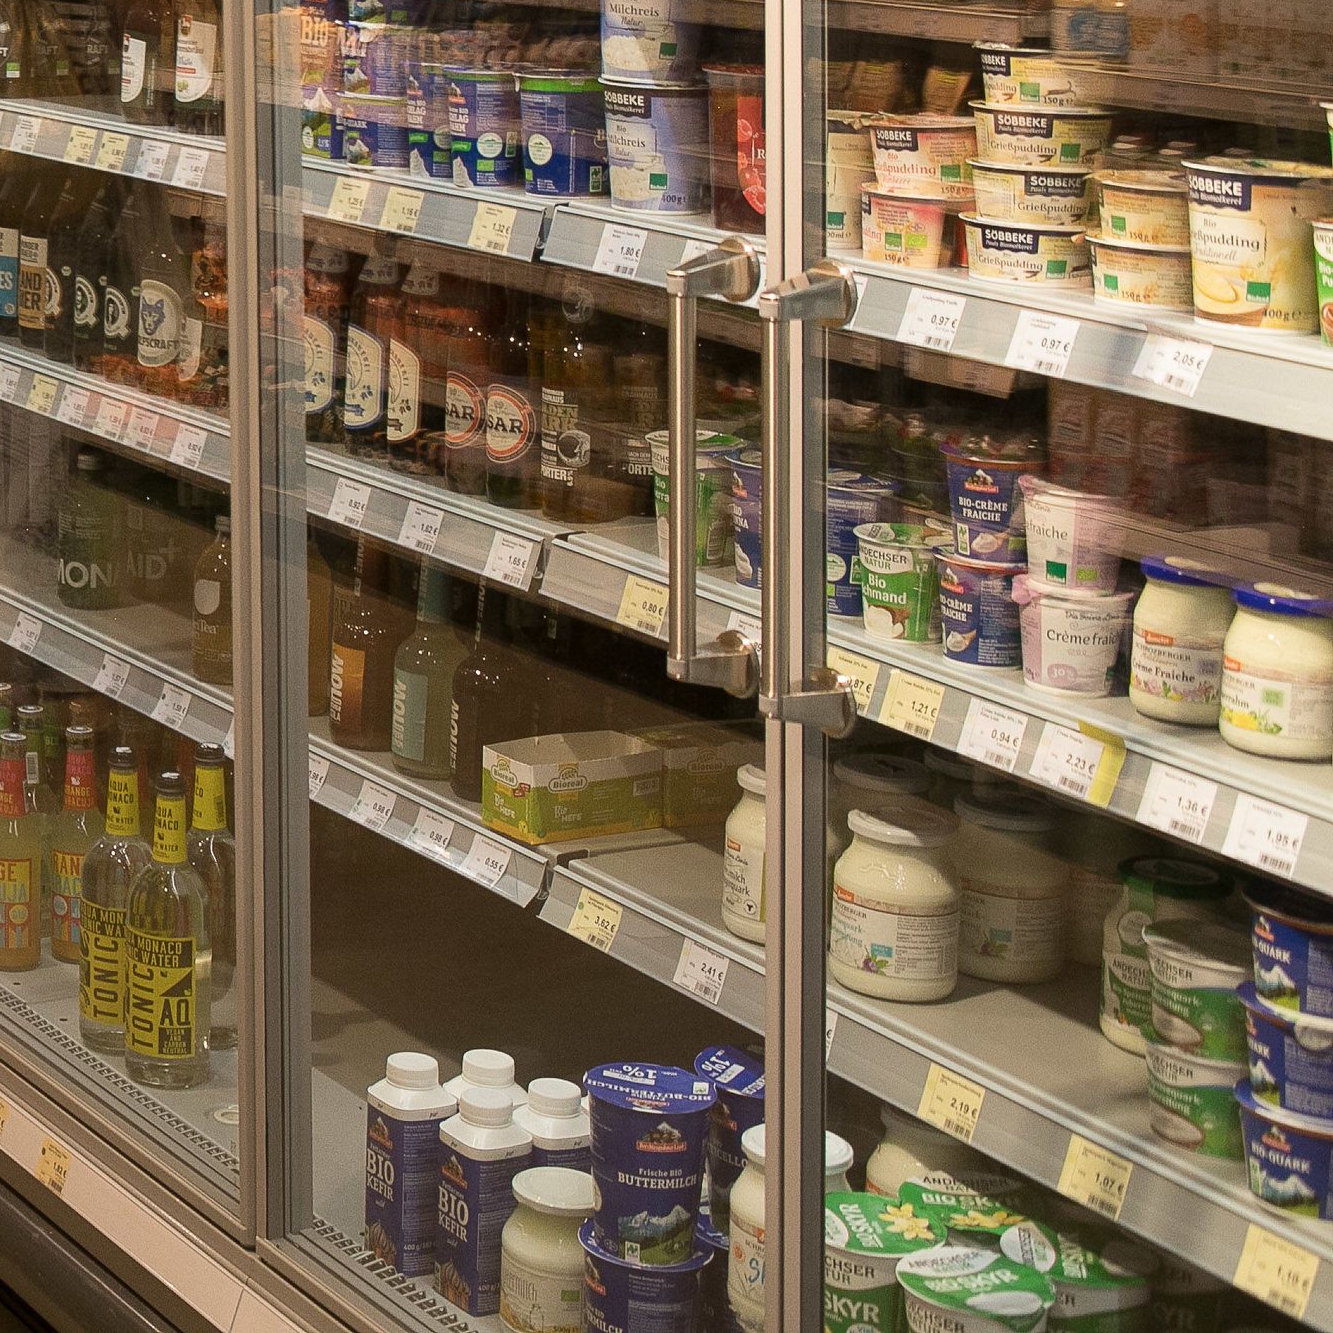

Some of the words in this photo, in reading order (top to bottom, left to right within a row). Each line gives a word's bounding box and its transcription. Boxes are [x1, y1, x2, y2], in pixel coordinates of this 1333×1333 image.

[609, 2, 660, 17] Milchreis
[620, 15, 644, 27] Natur
[604, 90, 645, 107] SÖBBEKE
[616, 124, 627, 133] Bio
[997, 114, 1048, 129] SÖBBEKE
[876, 129, 912, 142] SÖBBEKE
[887, 152, 899, 160] Bio
[990, 141, 1058, 156] Grießpudding
[1029, 175, 1083, 188] SÖBBEKE
[1188, 174, 1243, 197] SÖBBEKE
[1203, 218, 1217, 228] Bio
[985, 228, 1034, 245] SÖBBEKE
[1194, 233, 1261, 252] eßpudding
[620, 245, 635, 257] 1,80
[978, 256, 1044, 272] Grießpudding
[931, 314, 950, 326] 0,97
[1041, 339, 1061, 351] 0,97
[1173, 352, 1195, 366] 2,05
[958, 495, 1008, 512] BIO-CRÈME
[962, 508, 1001, 522] FRAICHE
[864, 556, 892, 571] NATUR
[868, 574, 886, 589] Bio
[641, 600, 659, 614] 0,80
[1046, 629, 1091, 646] Crème
[910, 700, 930, 716] 1,21
[991, 728, 1011, 745] 0,94
[1065, 753, 1087, 772] 2,23
[493, 770, 516, 785] Bioreal
[552, 779, 584, 790] Bioreal
[372, 802, 385, 814] 0,98
[429, 831, 443, 843] 0,98
[485, 857, 498, 870] 0,55
[99, 910, 126, 926] MON
[594, 915, 610, 930] 3,62
[105, 922, 126, 939] WAT
[136, 938, 183, 957] MONACO
[139, 951, 181, 969] WATER
[92, 936, 120, 1019] TONIC
[700, 962, 716, 977] 2,41
[132, 965, 156, 1050] TONIC
[159, 997, 192, 1028] AQ
[949, 1096, 970, 1116] 2,19
[366, 1147, 396, 1187] BIO
[638, 1168, 669, 1178] Frische
[670, 1168, 683, 1177] BIO
[366, 1172, 394, 1202] KEFIR
[617, 1172, 698, 1190] BUTTERMILCH
[1093, 1171, 1115, 1191] 1,07
[438, 1184, 470, 1227] BIO
[438, 1212, 468, 1243] KEFIR
[825, 1256, 875, 1279] CHSER
[825, 1269, 852, 1286] TUR
